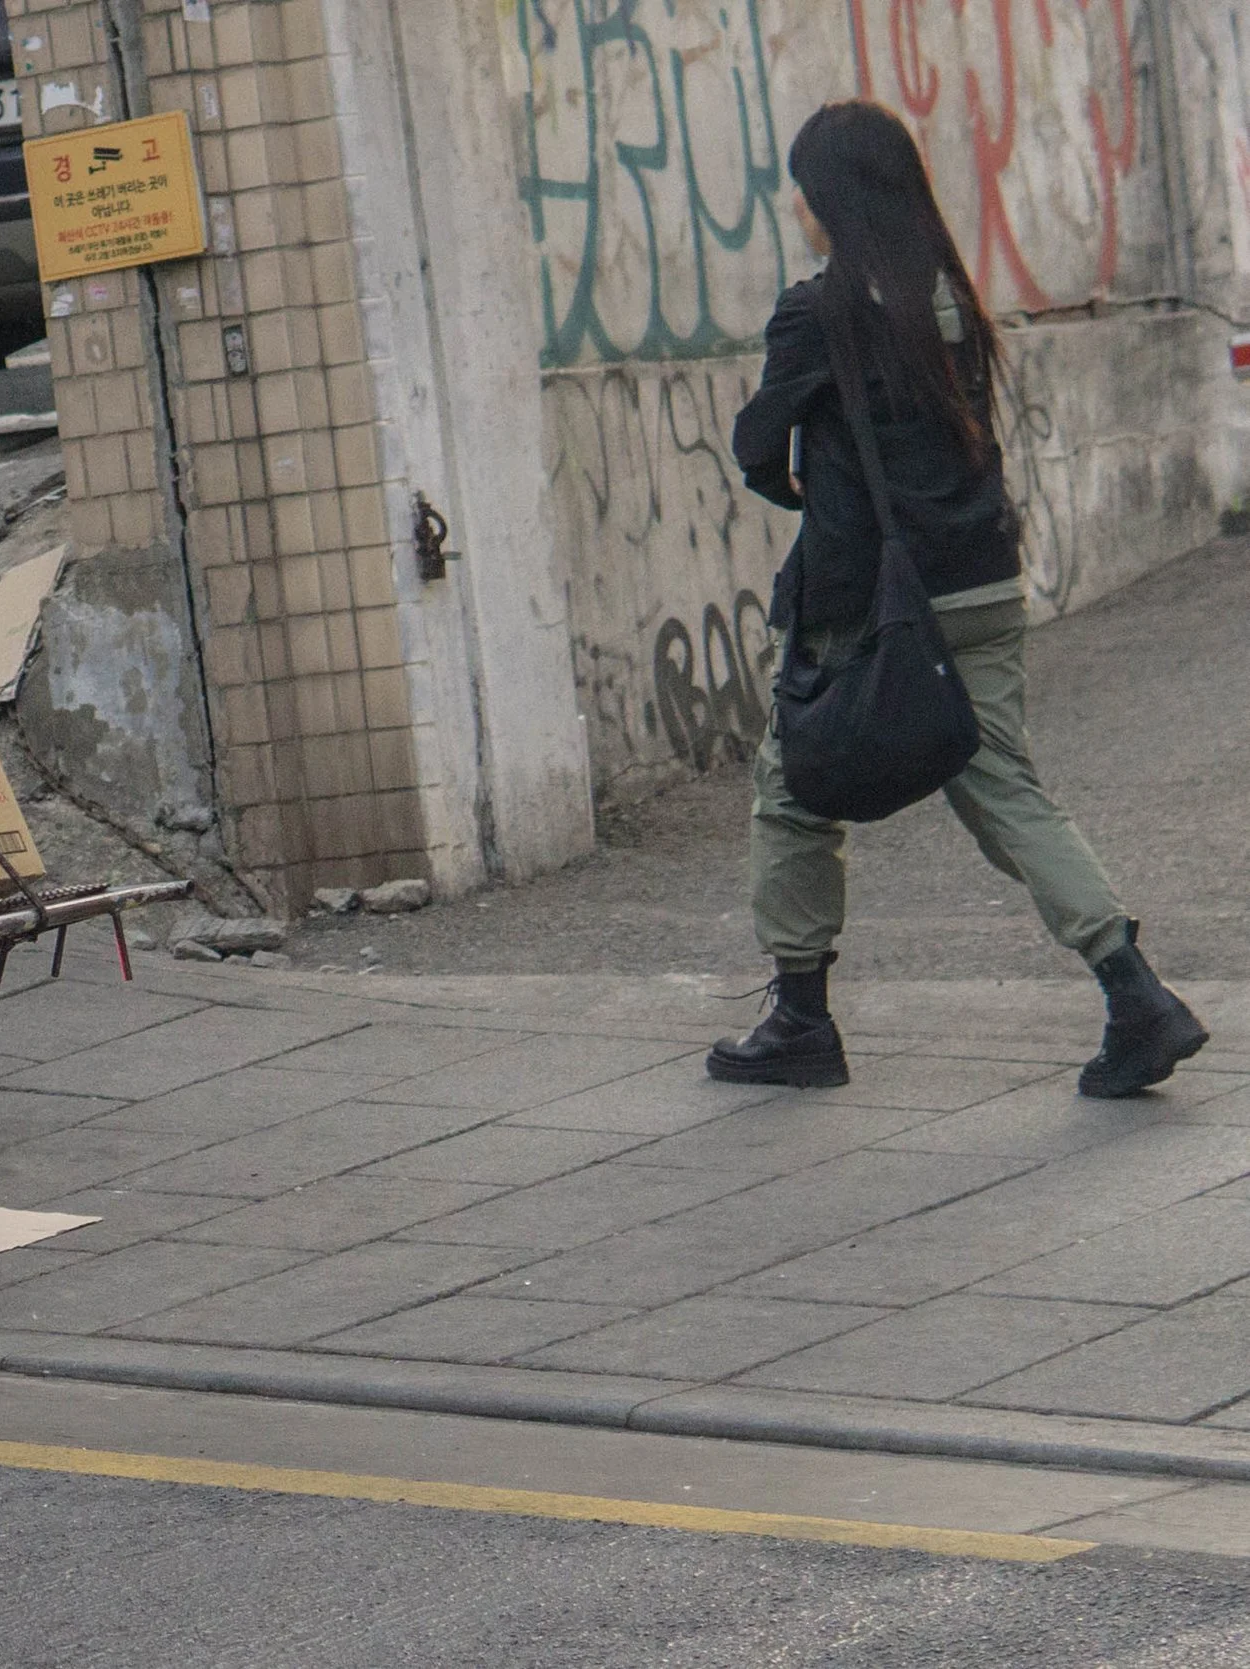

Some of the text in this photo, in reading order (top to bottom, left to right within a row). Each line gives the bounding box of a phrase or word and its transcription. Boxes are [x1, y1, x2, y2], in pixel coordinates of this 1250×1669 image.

[53, 139, 161, 183] 경 고
[87, 184, 116, 201] 쓰레기
